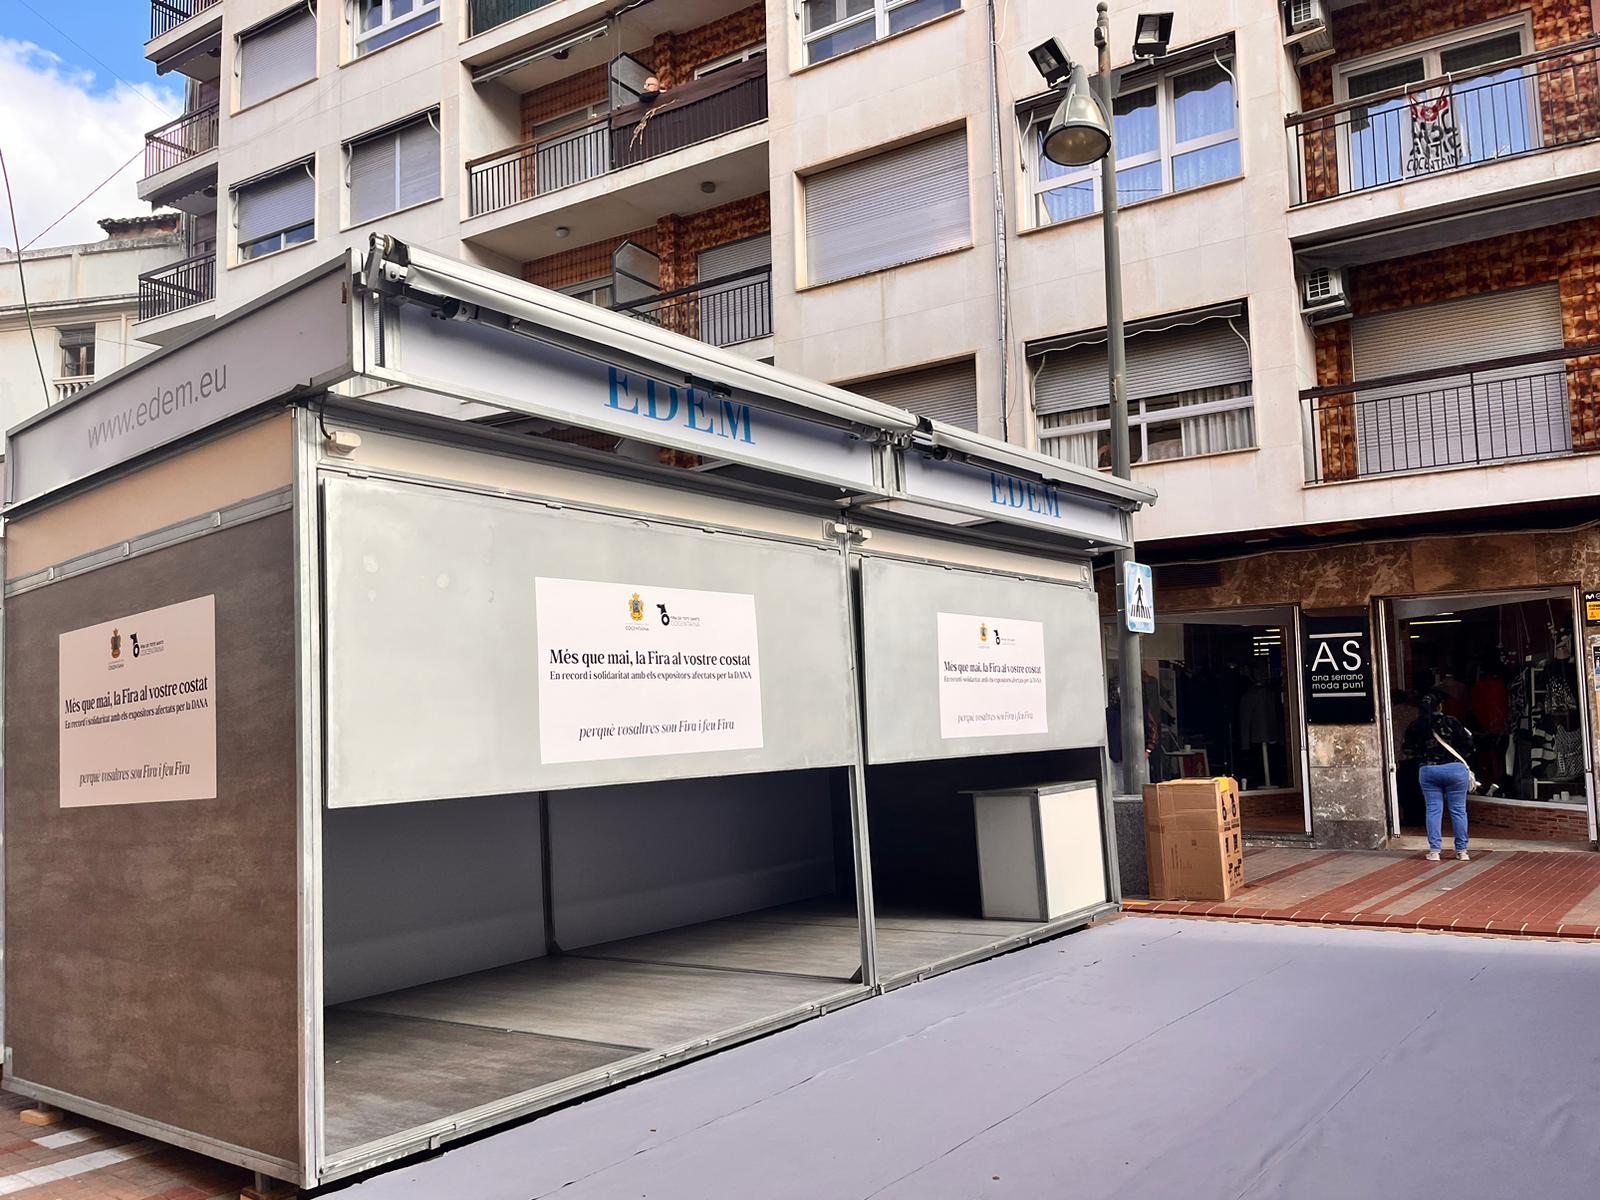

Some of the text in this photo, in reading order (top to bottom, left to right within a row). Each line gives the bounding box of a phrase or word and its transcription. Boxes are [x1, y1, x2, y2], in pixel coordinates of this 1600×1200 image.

[87, 364, 227, 449] www.edem.eu
[604, 366, 756, 445] EDEM
[990, 472, 1061, 518] EDEM
[550, 648, 751, 668] Més que mai, la Fira al vostre costat
[1311, 640, 1362, 671] AS
[550, 671, 560, 680] En
[562, 671, 588, 680] record
[593, 670, 629, 680] solidaritat
[631, 671, 646, 680] amb
[646, 671, 656, 680] els
[657, 671, 691, 681] expositors
[692, 671, 716, 680] afectats
[716, 673, 726, 681] per
[727, 671, 733, 680] la
[1342, 681, 1364, 690] punt
[65, 698, 80, 714] Més
[82, 698, 95, 714] que
[113, 691, 121, 705] la
[122, 688, 139, 704] Fira
[140, 685, 148, 701] al
[149, 683, 177, 699] vostre
[178, 676, 208, 695] costat
[579, 723, 615, 741] perquè
[617, 722, 660, 736] vosaltres
[661, 723, 678, 734] sou
[679, 720, 697, 733] Fira
[701, 719, 716, 734] feu
[717, 718, 735, 731] Fira
